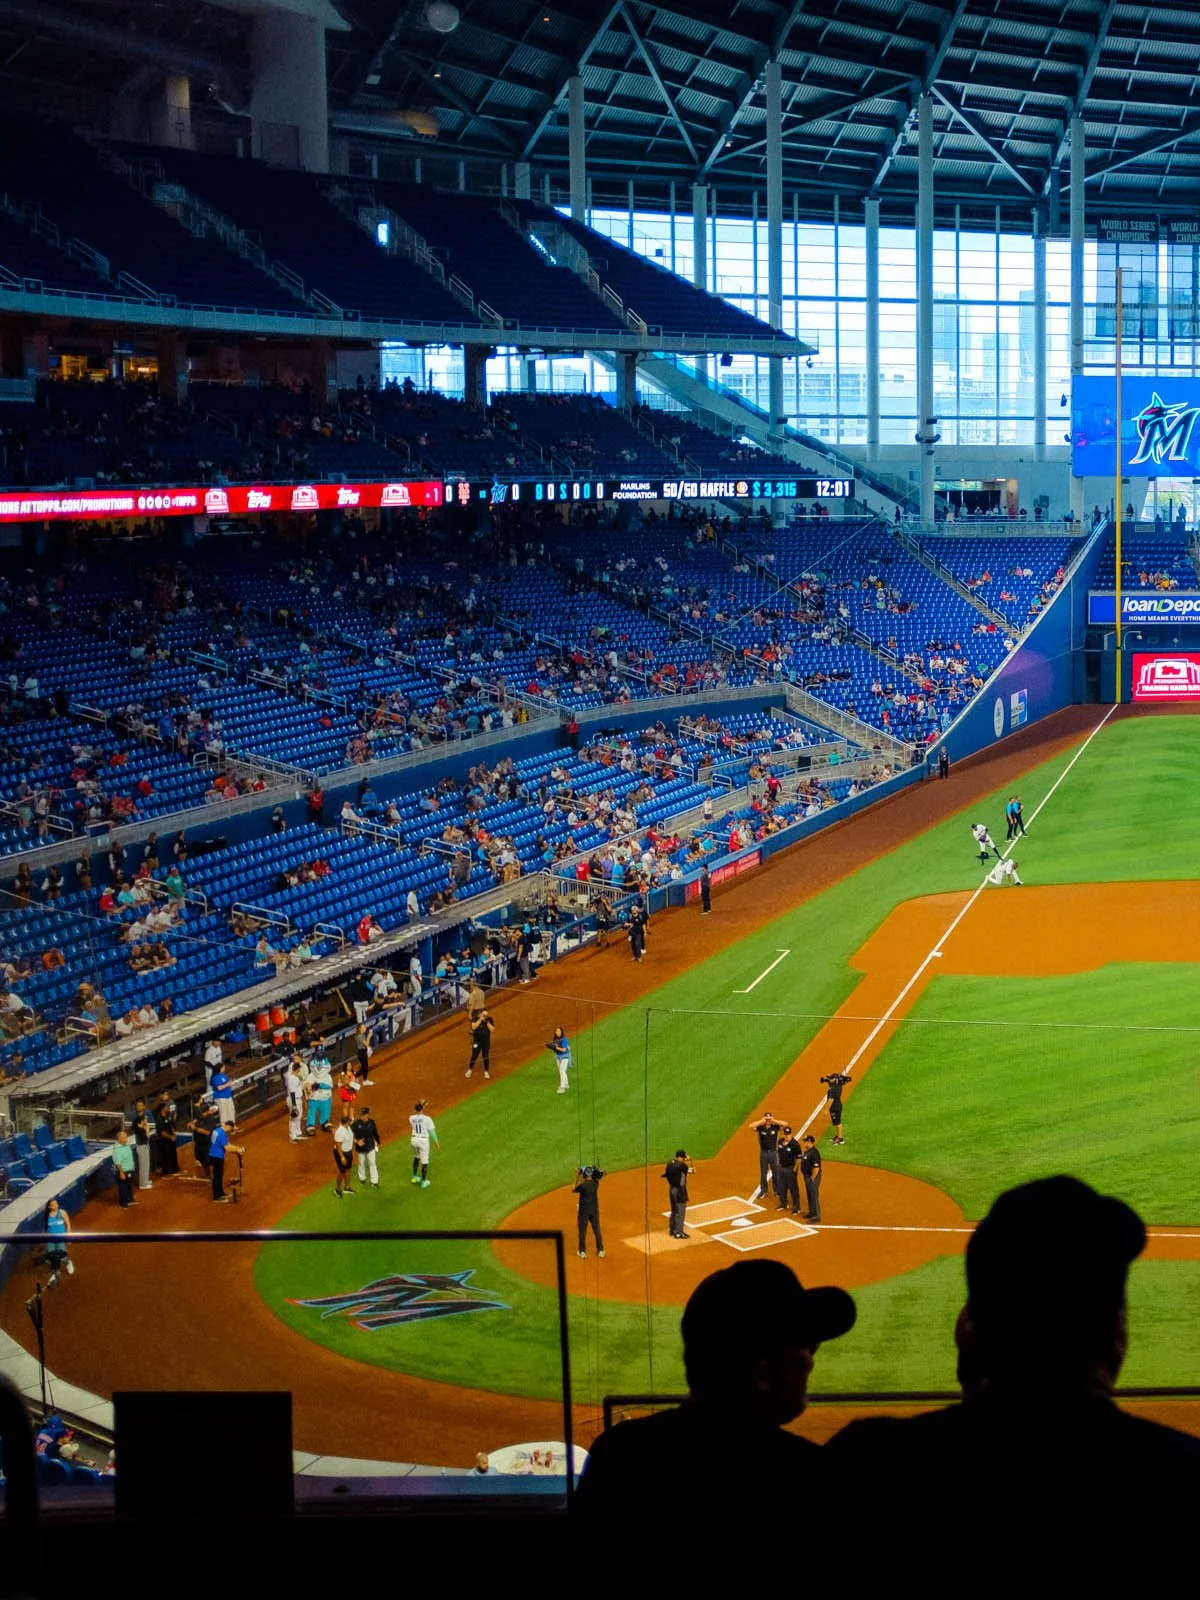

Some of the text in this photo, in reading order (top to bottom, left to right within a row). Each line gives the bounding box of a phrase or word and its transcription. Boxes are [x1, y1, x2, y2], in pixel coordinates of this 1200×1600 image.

[1100, 219, 1156, 231] WORLD SERIES
[1170, 222, 1198, 232] WORLD
[1106, 231, 1151, 241] CHAMPIONS
[620, 483, 650, 491] MARLINS
[663, 481, 734, 499] 50/50 RAFFLE
[764, 481, 797, 498] 3,315
[816, 481, 849, 497] 12:01
[613, 492, 657, 500] FOUNDATION
